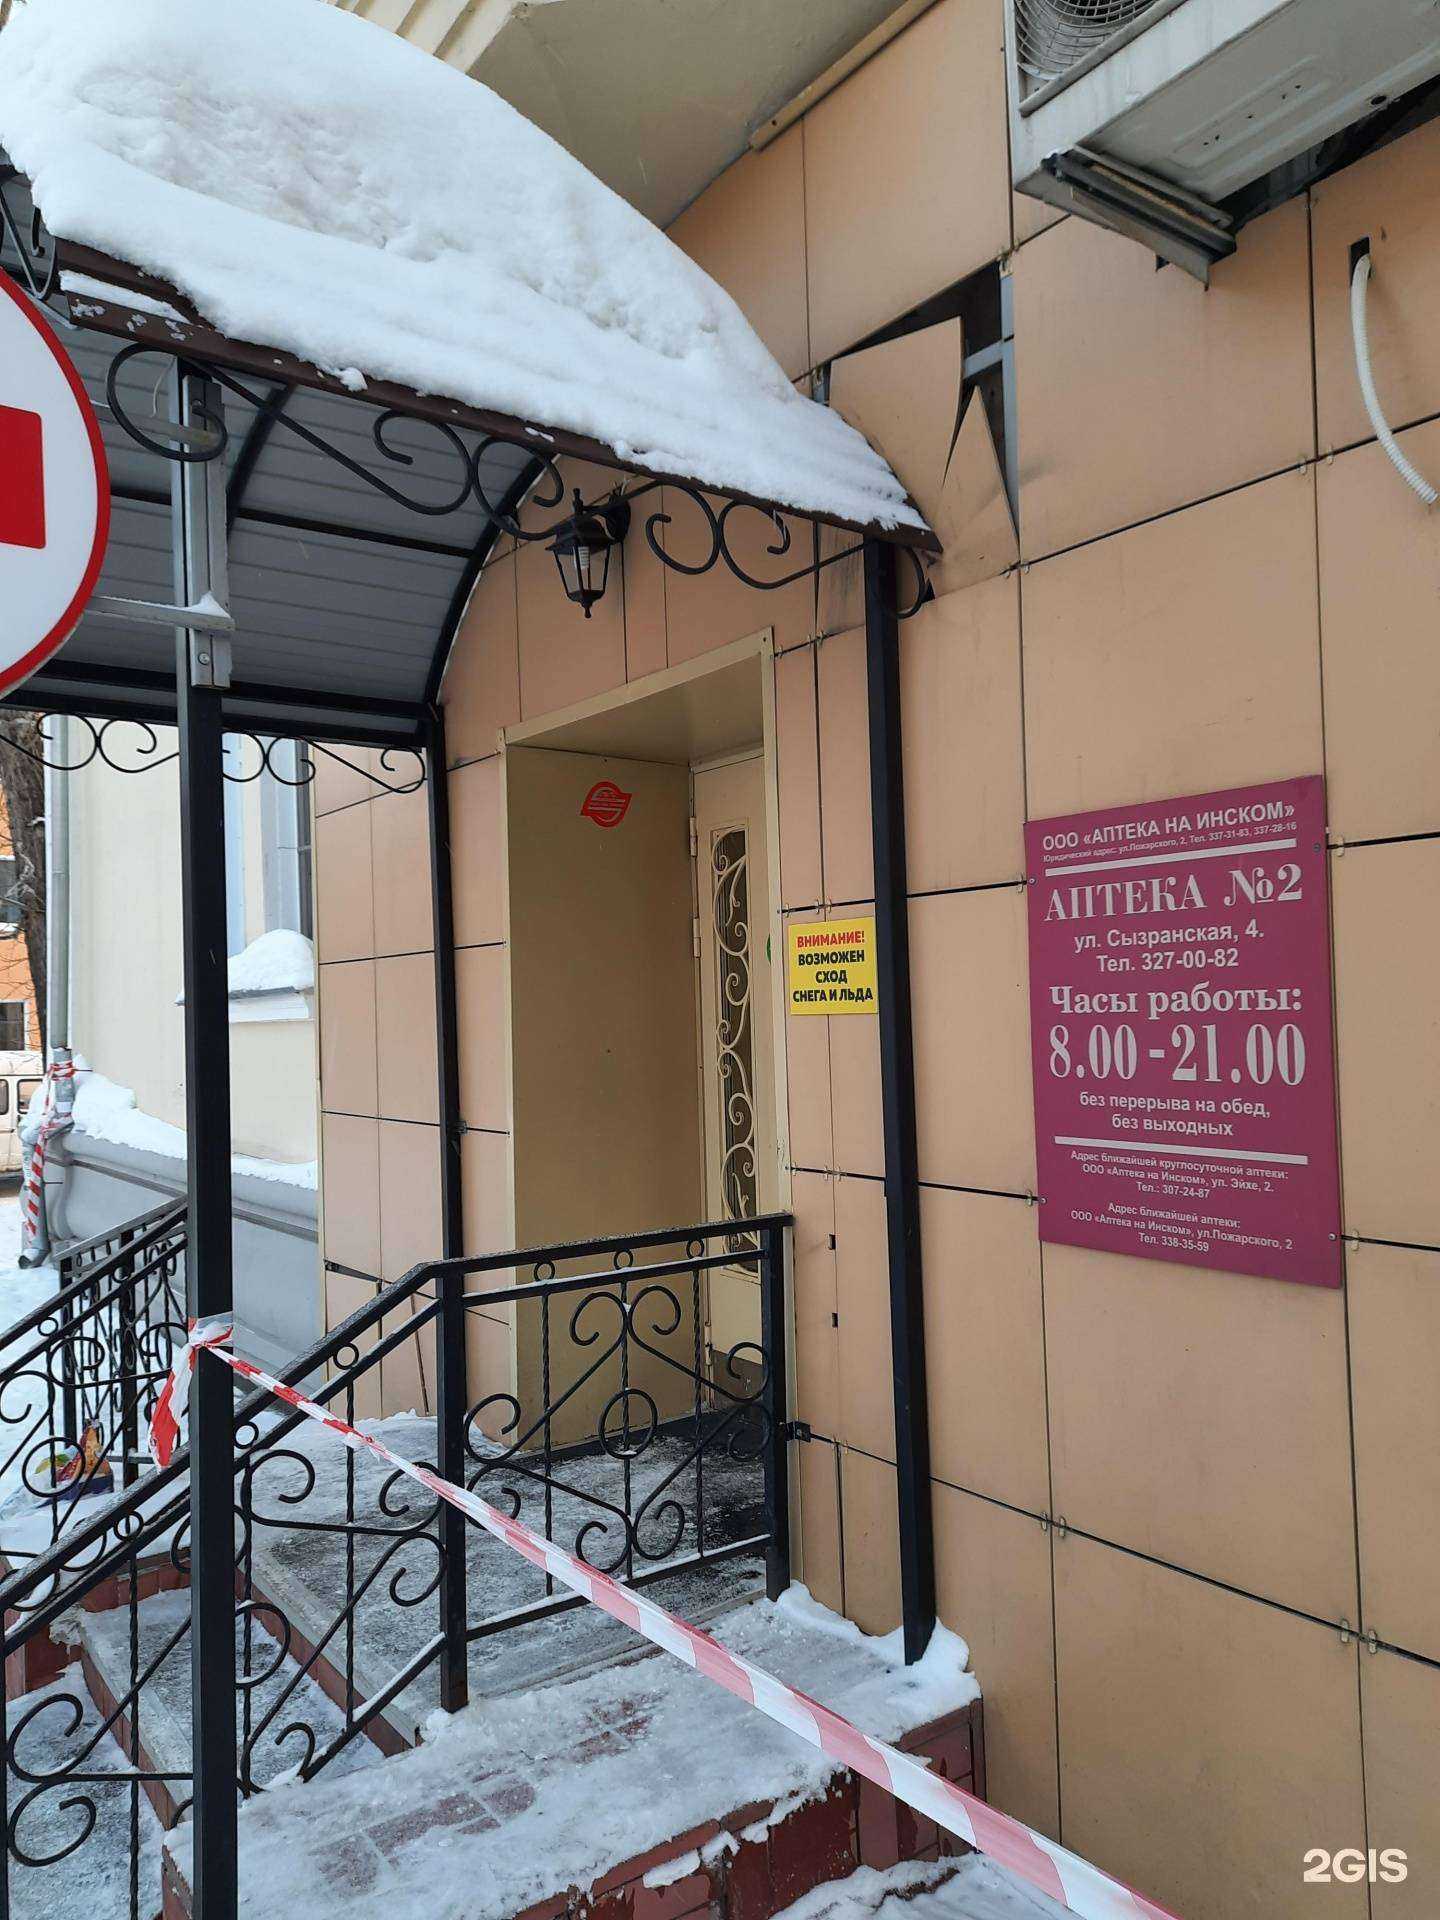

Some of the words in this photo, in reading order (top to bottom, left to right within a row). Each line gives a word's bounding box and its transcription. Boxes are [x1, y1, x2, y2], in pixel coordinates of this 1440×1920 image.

[1043, 832, 1078, 850] ООО
[1083, 820, 1160, 845] «АПТЕКА
[1165, 815, 1192, 834] НА
[1196, 801, 1295, 829] ИНСКОМ»
[1044, 873, 1207, 921] АПТЕКА
[1224, 863, 1302, 906] №2
[797, 931, 865, 948] ВНИМАНИЕ!
[1074, 935, 1101, 953] ул.
[1107, 925, 1239, 948] Сызранская,
[1245, 919, 1264, 938] 4.
[798, 950, 865, 966] ВОЗМОЖЕН
[1096, 954, 1136, 972] Тел.
[1141, 948, 1239, 970] 327-00-82
[815, 970, 848, 984] СХОД
[793, 989, 827, 1003] СНЕГА
[829, 988, 837, 1002] И
[839, 987, 873, 1002] ЛЬДА
[1049, 985, 1138, 1014] Часы
[1148, 981, 1302, 1019] работы:
[1080, 1092, 1105, 1106] без
[1110, 1095, 1190, 1112] перерыва
[1196, 1100, 1215, 1112] на
[1221, 1098, 1270, 1118] обед,
[1112, 1114, 1138, 1129] без
[1143, 1119, 1233, 1136] выходных
[1071, 1150, 1099, 1161] Адрес
[1101, 1153, 1156, 1167] ближайшей
[1160, 1159, 1243, 1175] круглосуточной
[1246, 1167, 1289, 1179] аптеки:
[1082, 1164, 1104, 1174] ООО
[1107, 1166, 1145, 1179] «Аптека
[1147, 1171, 1159, 1180] на
[1211, 1179, 1228, 1189] ул.
[1264, 1181, 1274, 1192] 2.
[1108, 1203, 1137, 1215] Адрес
[1140, 1206, 1198, 1222] ближайшей
[1201, 1216, 1241, 1228] аптеки:
[1070, 1210, 1092, 1221] ООО
[1094, 1214, 1132, 1227] «Аптека
[1134, 1221, 1145, 1229] на
[1285, 1239, 1293, 1250] 2
[1139, 1232, 1159, 1244] Тел.
[1162, 1236, 1209, 1252] 338-35-59
